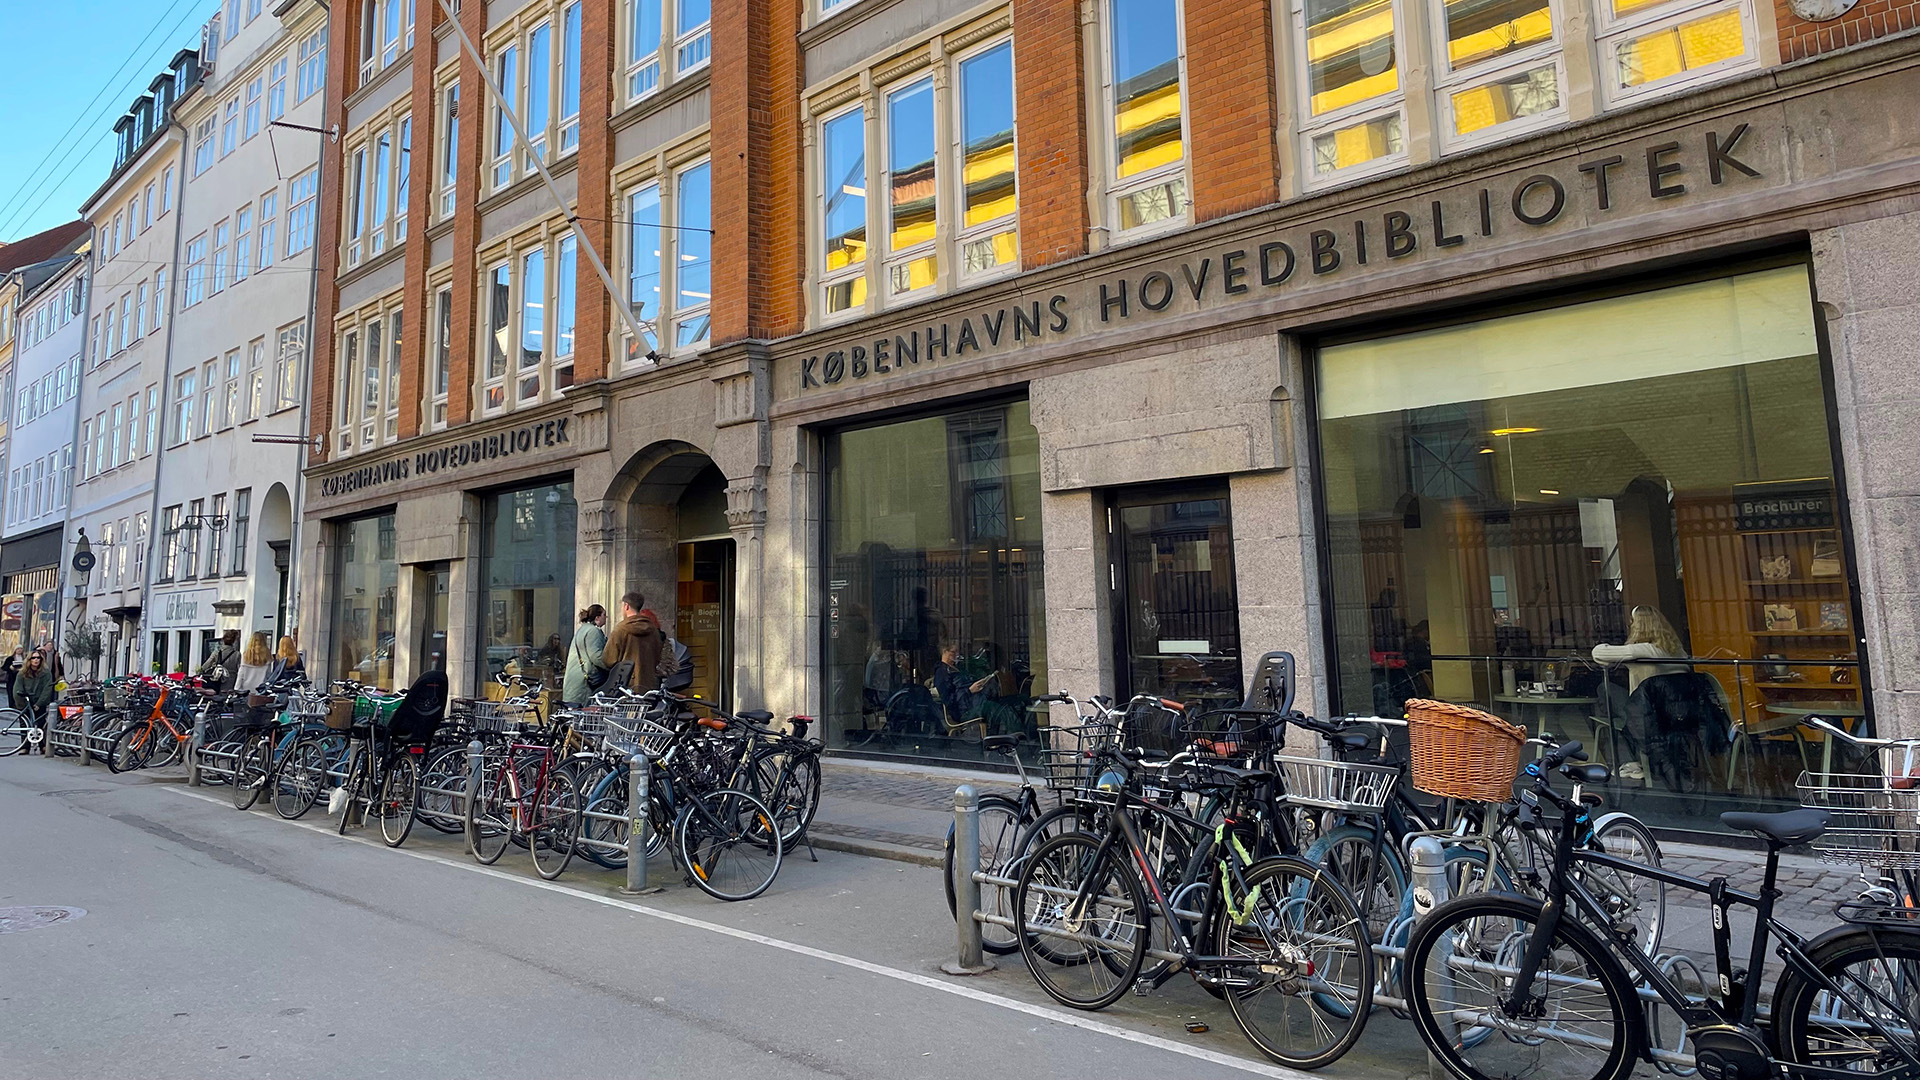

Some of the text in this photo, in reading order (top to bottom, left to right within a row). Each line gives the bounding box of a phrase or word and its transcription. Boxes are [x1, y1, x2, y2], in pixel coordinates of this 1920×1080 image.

[801, 123, 1761, 389] KØBENHAVNS HOVEDBIBLIOTEK
[321, 417, 569, 497] KØBENHAVNS HOVEDBIBLIOTEK
[1743, 500, 1823, 514] Brochurer
